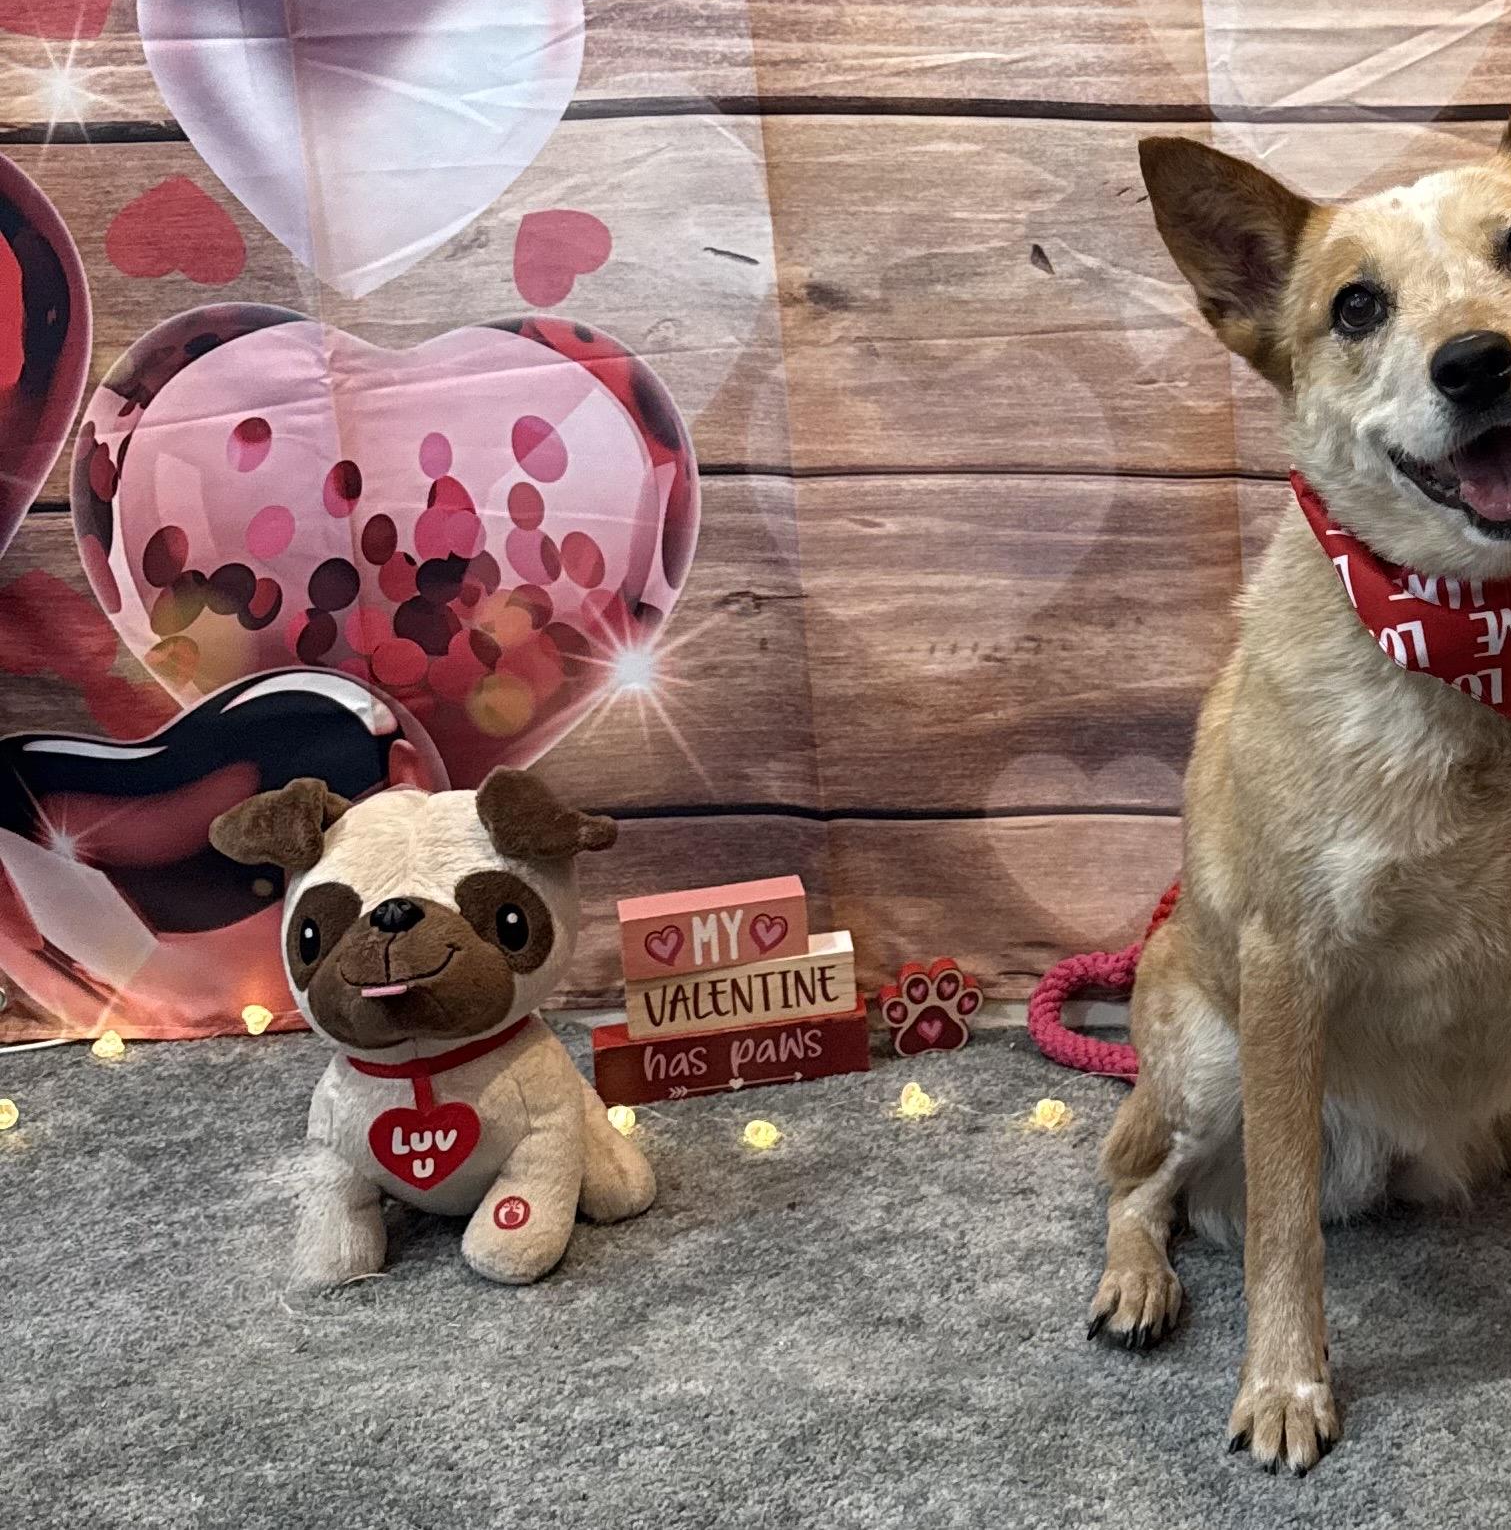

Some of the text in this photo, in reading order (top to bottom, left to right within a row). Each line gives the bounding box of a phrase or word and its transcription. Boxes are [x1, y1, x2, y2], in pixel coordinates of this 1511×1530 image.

[692, 910, 744, 966] MY
[644, 964, 839, 1027] VALENTINE
[643, 1027, 823, 1082] has paws
